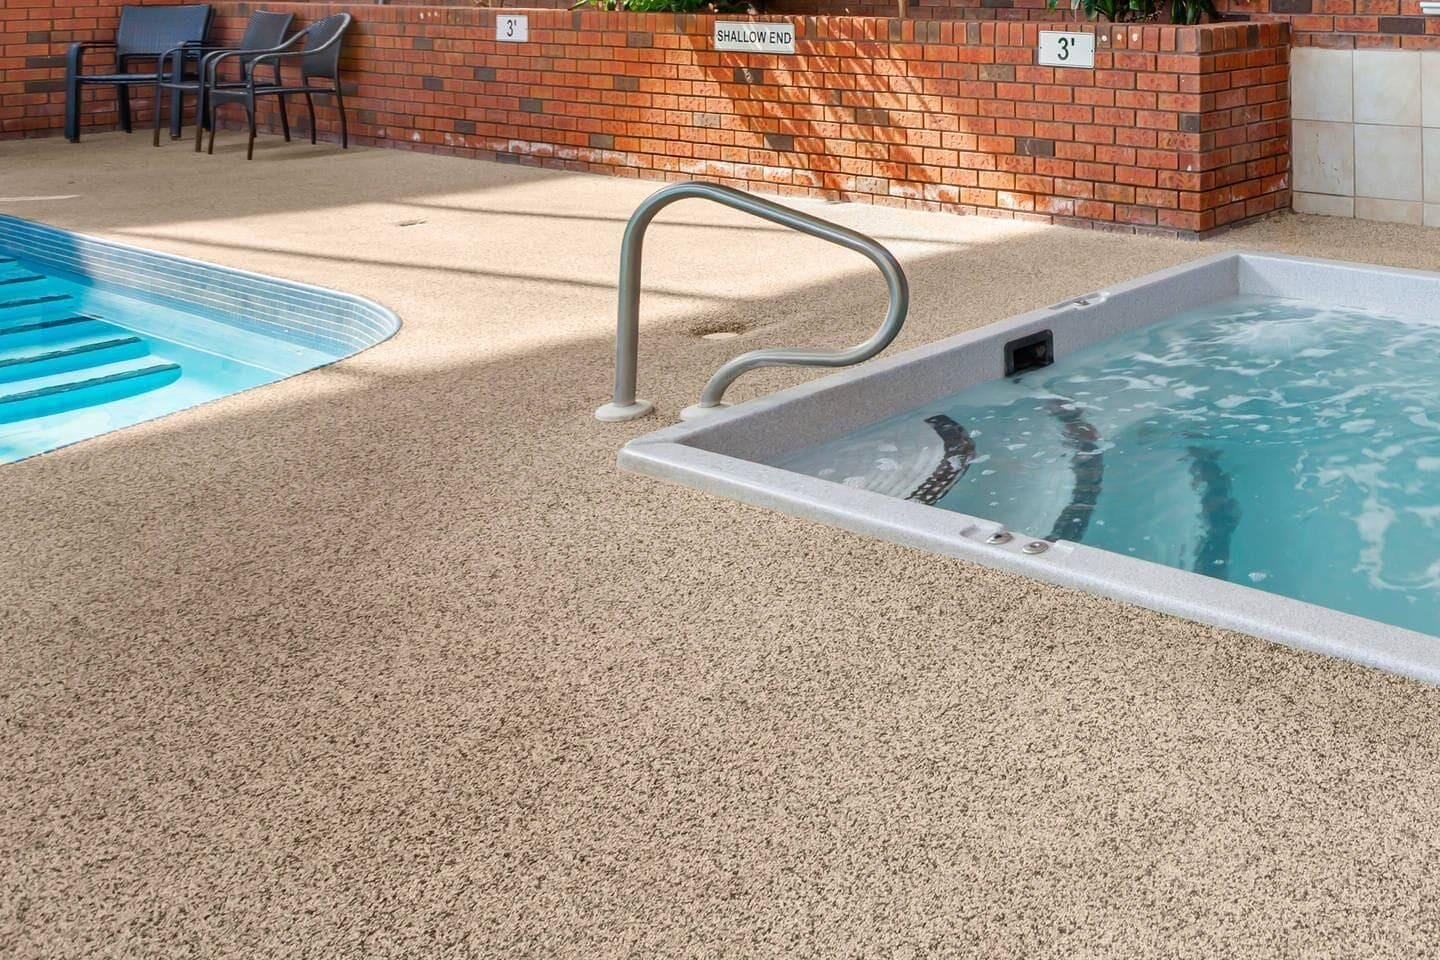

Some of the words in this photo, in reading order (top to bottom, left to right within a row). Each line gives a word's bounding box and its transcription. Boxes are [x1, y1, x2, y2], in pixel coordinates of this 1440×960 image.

[717, 29, 767, 43] SHALLOW
[769, 31, 792, 44] END
[1057, 37, 1075, 60] 3'
